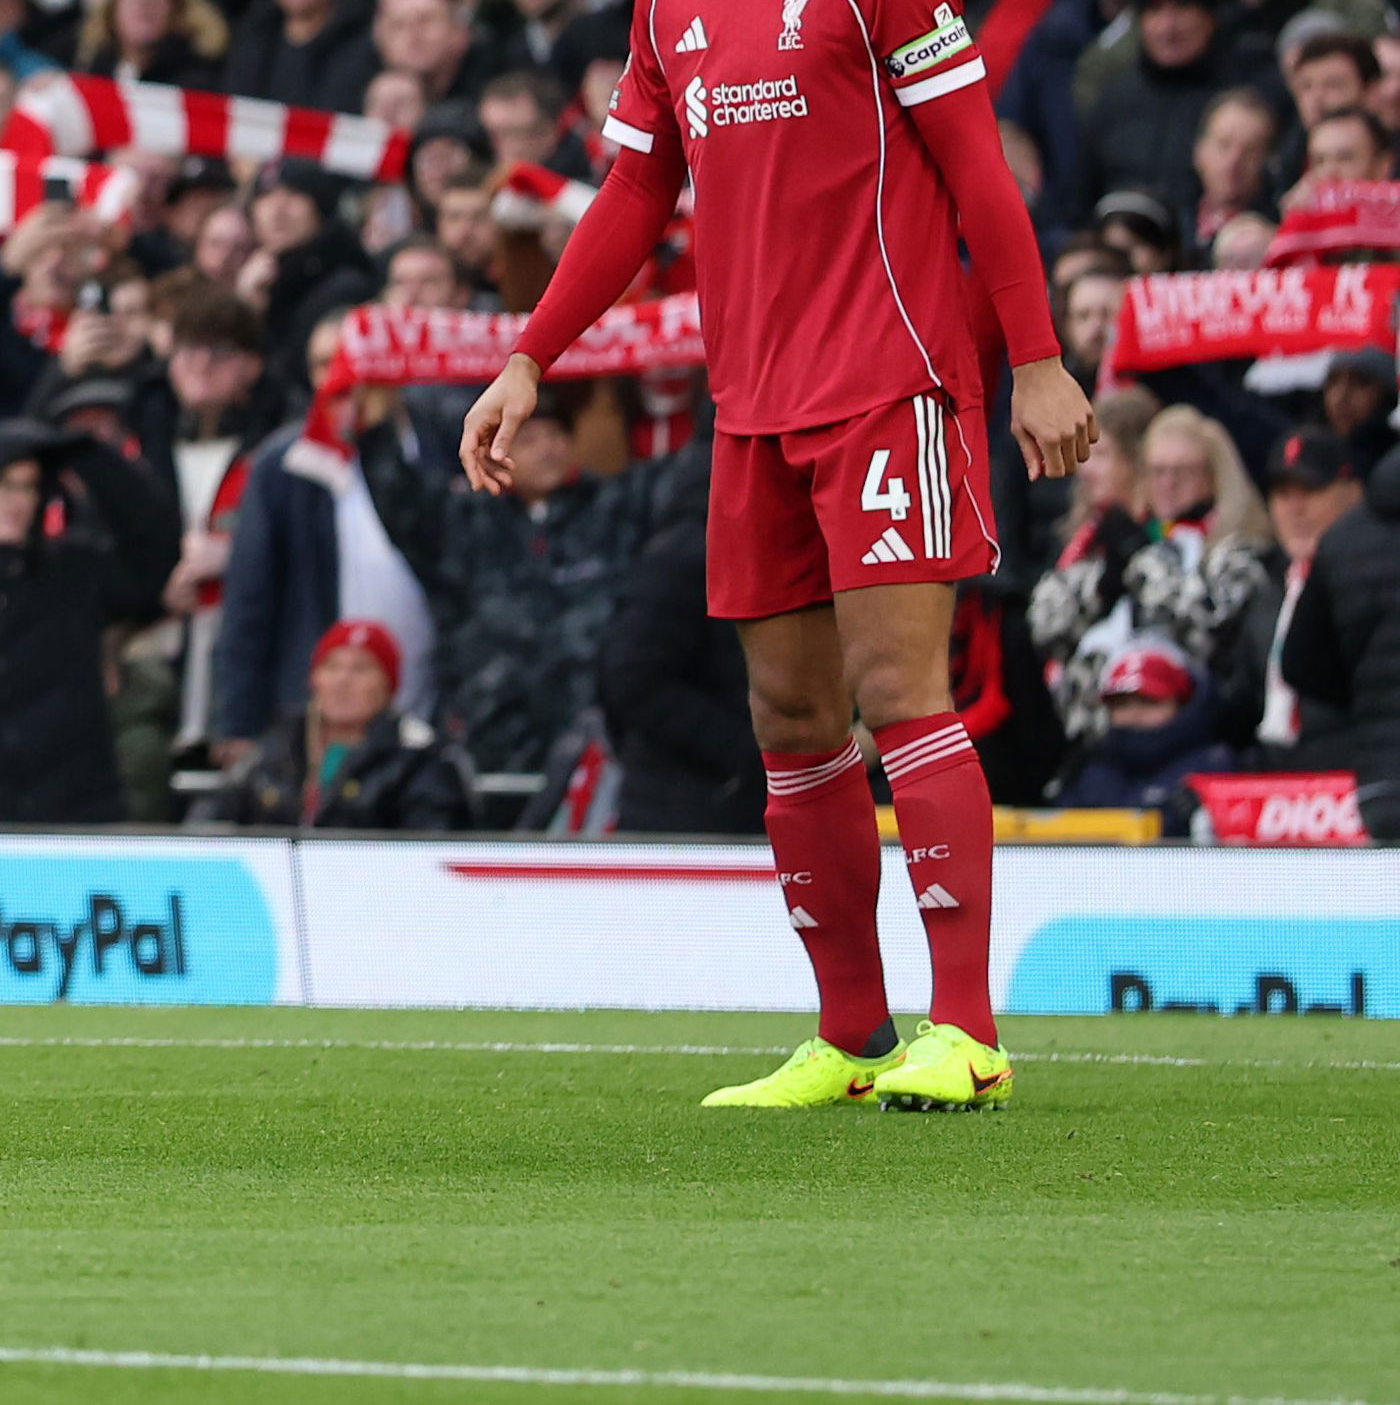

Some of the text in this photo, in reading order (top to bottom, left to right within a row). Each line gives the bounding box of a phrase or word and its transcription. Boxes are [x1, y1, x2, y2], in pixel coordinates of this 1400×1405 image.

[711, 74, 797, 105] standard
[711, 95, 808, 127] chartered
[861, 449, 911, 521] 4
[777, 871, 813, 886] FC
